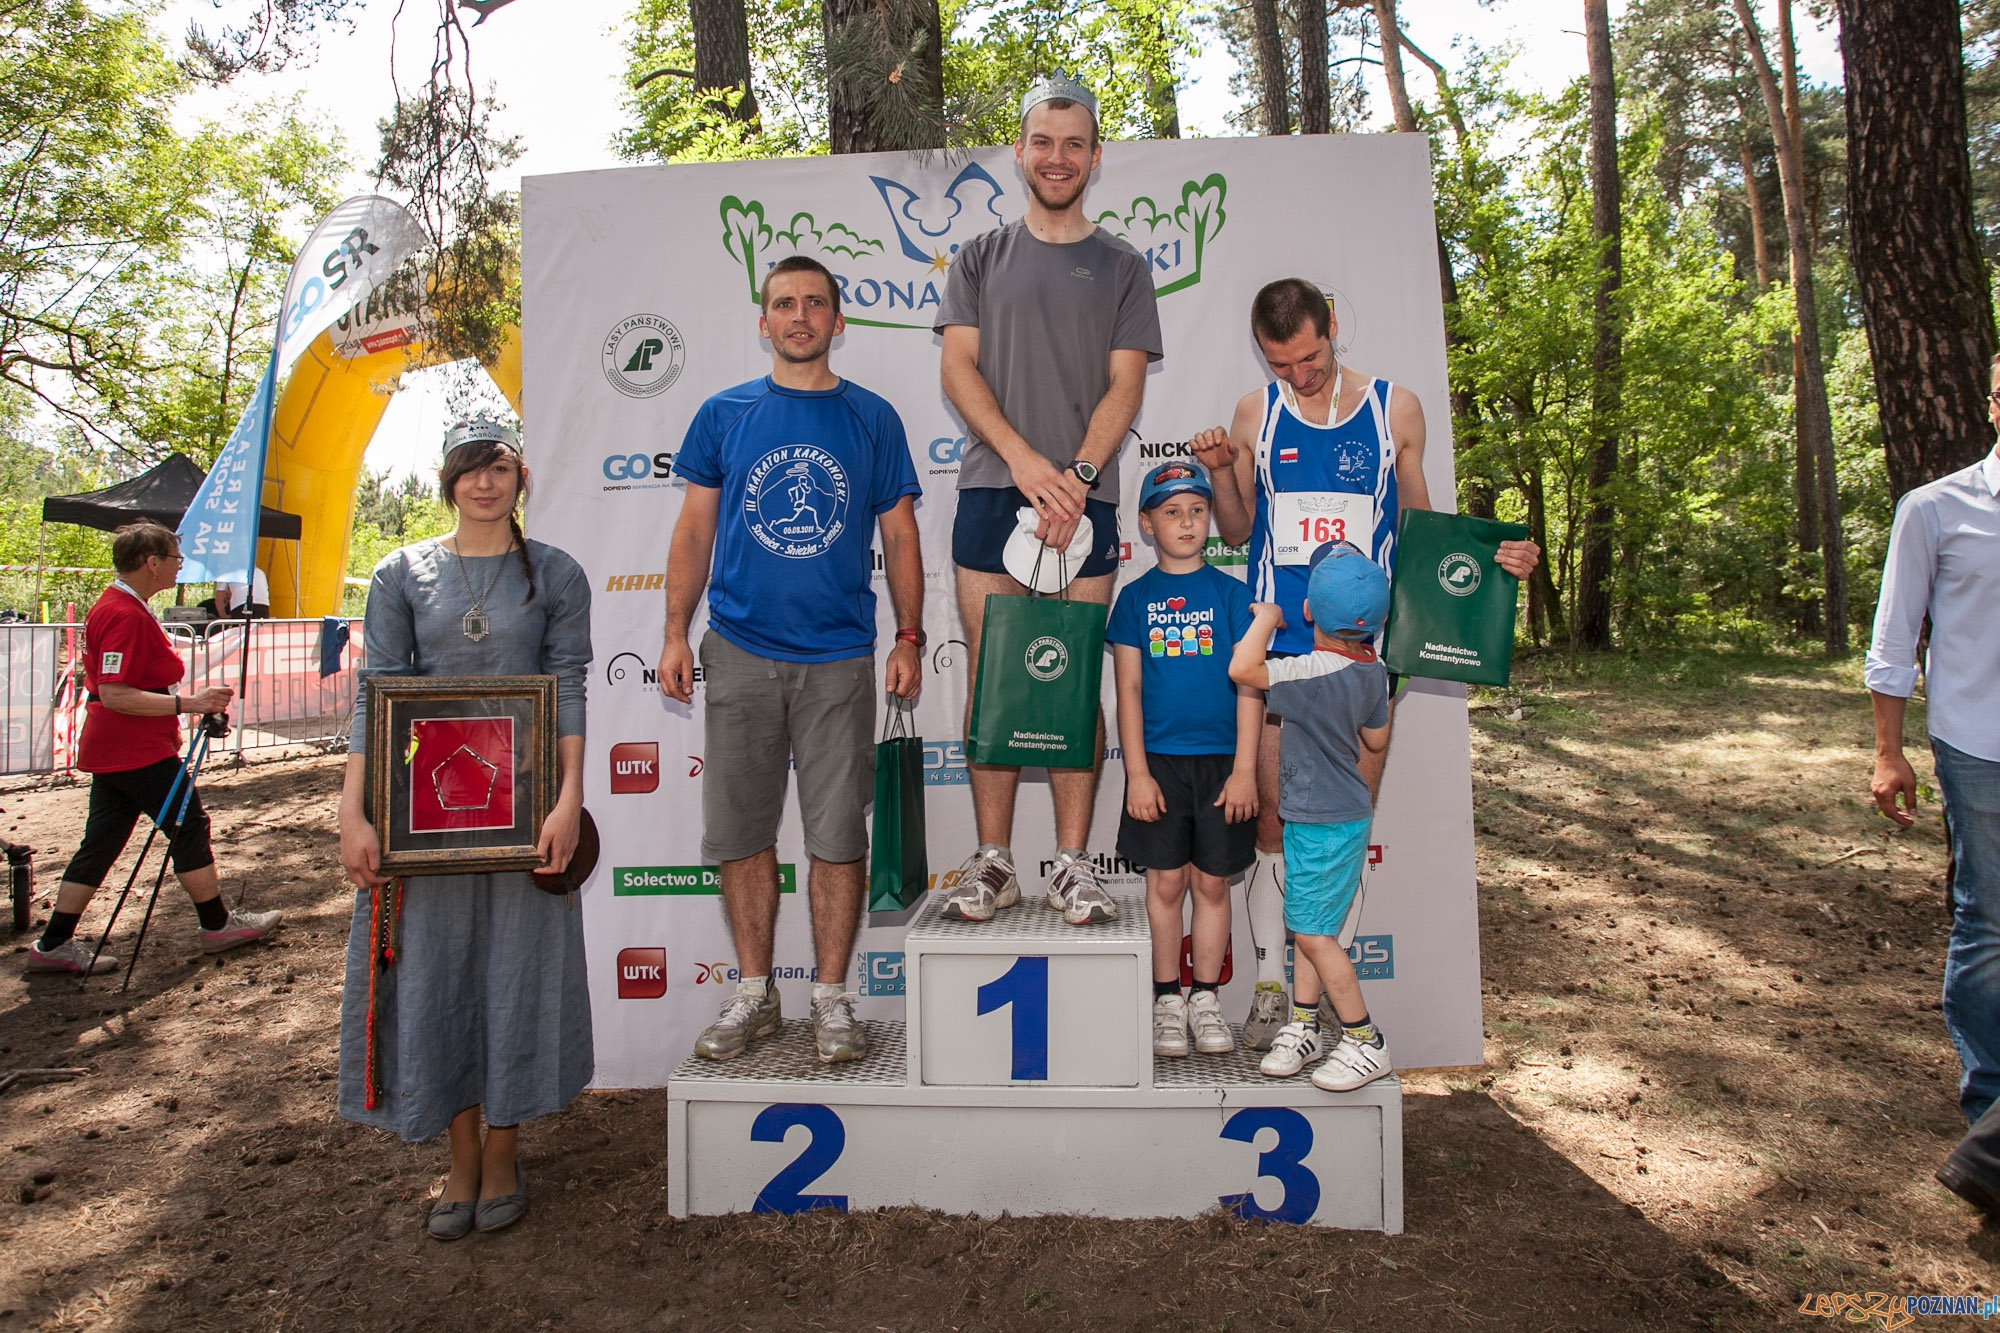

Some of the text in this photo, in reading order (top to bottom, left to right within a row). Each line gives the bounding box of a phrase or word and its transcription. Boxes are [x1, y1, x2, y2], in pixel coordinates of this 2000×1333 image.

[605, 316, 682, 355] LASY PAŃSTWOWE
[1140, 441, 1195, 458] NICK
[745, 447, 846, 512] III MARATON KARKONOSKI
[1298, 517, 1346, 543] 163
[1147, 601, 1167, 612] eu
[1147, 607, 1214, 626] Portugal
[1425, 641, 1478, 657] Nadleśnictwo
[1419, 650, 1482, 667] Konstantynowo
[1013, 730, 1065, 742] Nadleśnictwo
[1008, 740, 1068, 751] Konstantynowo
[623, 871, 698, 888] Sołectwo
[977, 956, 1049, 1081] 1
[750, 1102, 849, 1214] 2
[1218, 1107, 1321, 1225] 3
